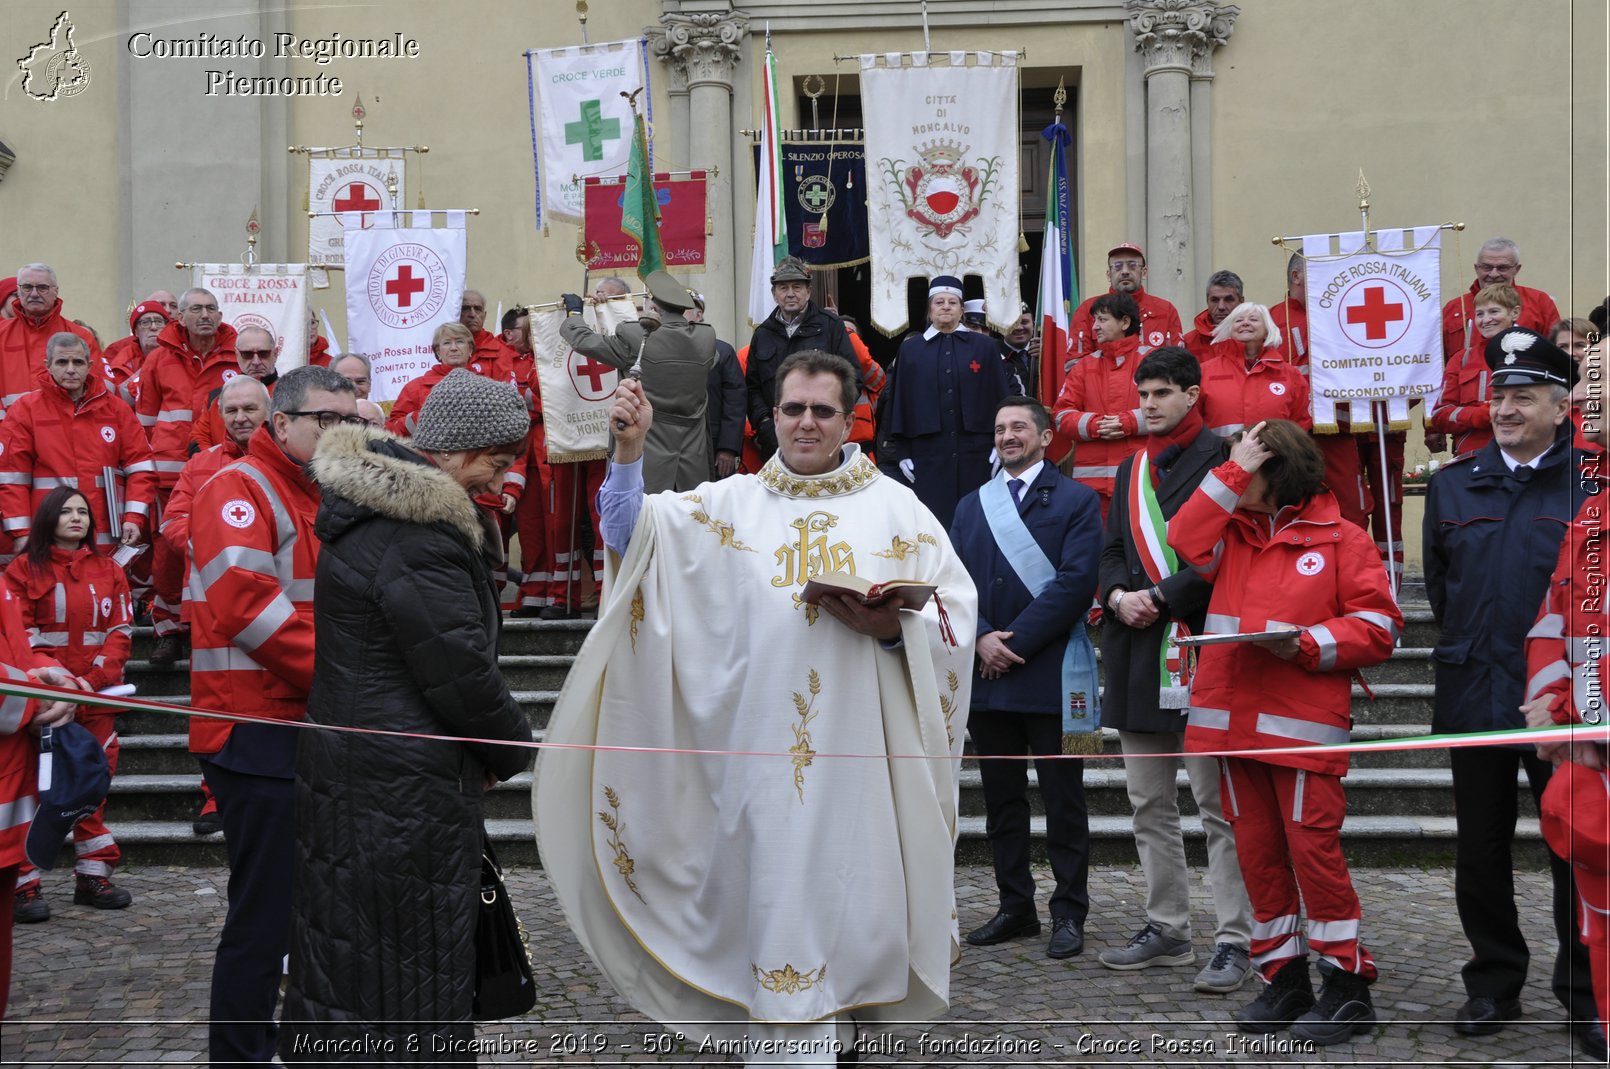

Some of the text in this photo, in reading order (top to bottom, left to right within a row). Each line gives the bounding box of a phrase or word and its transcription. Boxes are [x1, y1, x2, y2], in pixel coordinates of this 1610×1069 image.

[552, 67, 626, 84] CROCE VERDE
[936, 108, 947, 118] DI
[911, 122, 970, 135] MONCALVO
[788, 152, 825, 161] SILENZIO
[316, 163, 390, 201] CROCE ROSSA ITAL
[210, 278, 298, 289] CROCE ROSSA
[369, 246, 445, 326] CONVENZIONE DI GINEVRA 22 AGOSTO 1864
[1319, 261, 1432, 309] CROCE ROSSA ITALIANA
[223, 292, 284, 304] ITALIANA
[384, 347, 412, 357] Rossa
[415, 345, 434, 354] Itali
[375, 361, 431, 374] COMITATO DI
[1321, 353, 1431, 369] COMITATO LOCALE
[391, 375, 410, 384] ASTI
[1373, 372, 1385, 382] DI
[1323, 383, 1434, 399] COCCONATO D'ASTI
[576, 420, 608, 437] MONC
